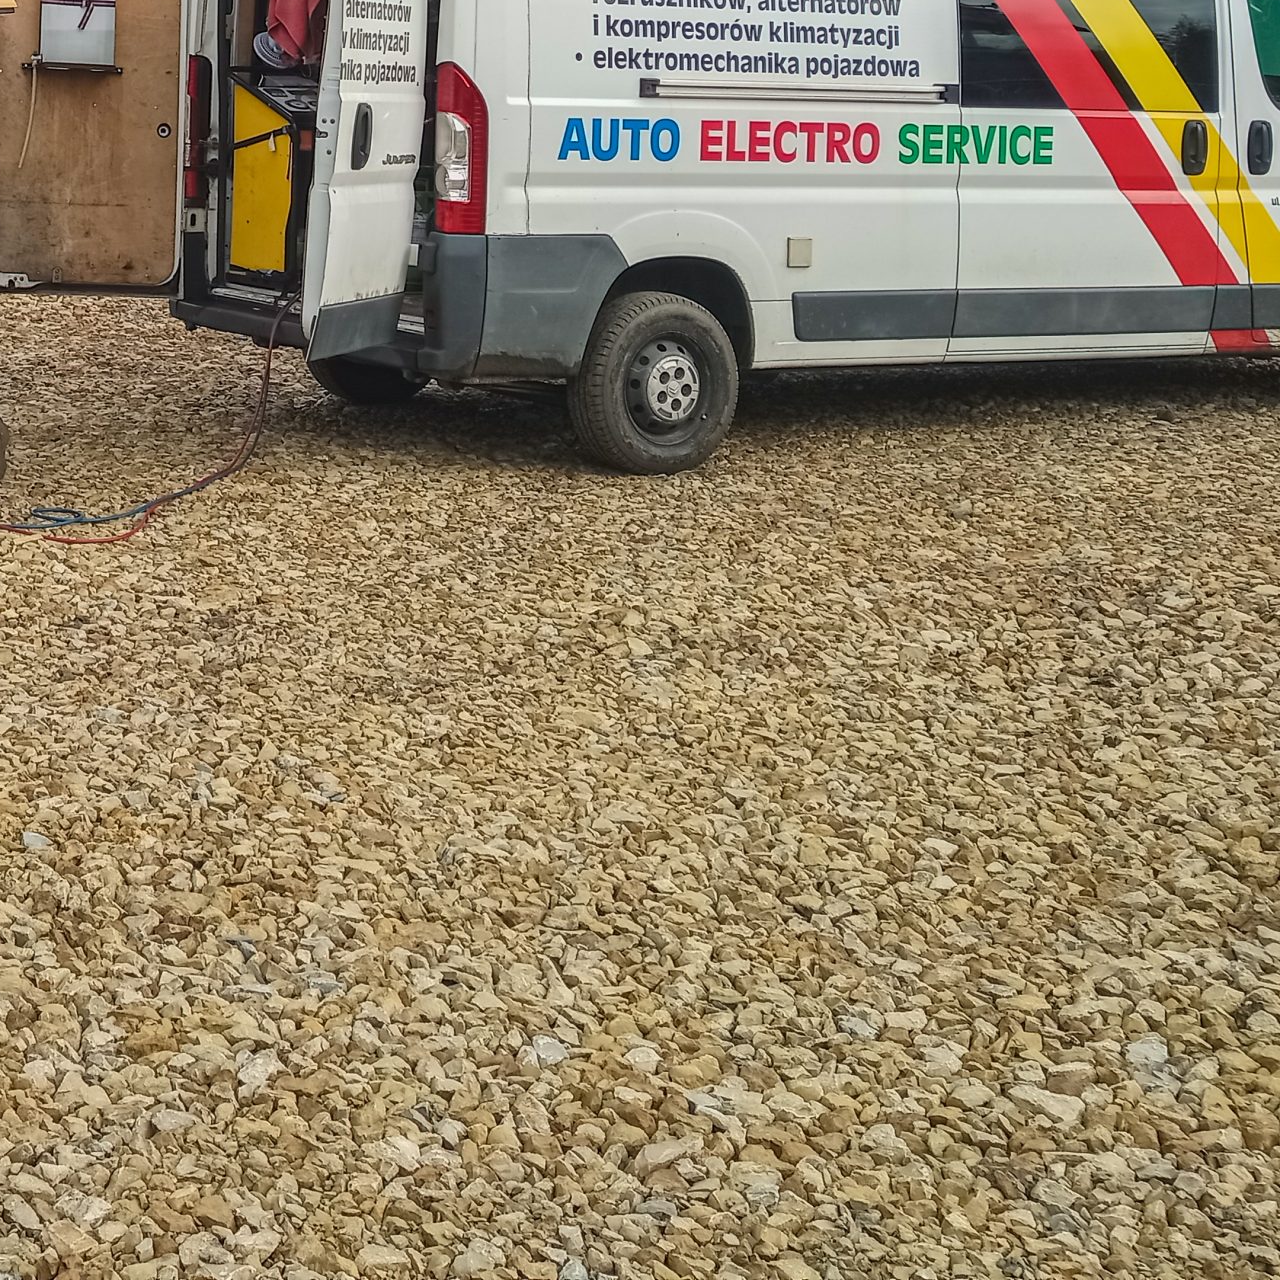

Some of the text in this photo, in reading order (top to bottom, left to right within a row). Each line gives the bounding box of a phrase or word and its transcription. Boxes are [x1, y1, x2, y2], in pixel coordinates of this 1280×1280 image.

[349, 27, 410, 56] klimatyzacji
[593, 14, 900, 50] i kompresorów klimatyzacji
[364, 61, 417, 85] pojazdowa
[593, 47, 920, 79] elektromechanika pojazdowa
[558, 117, 1054, 166] AUTO ELECTRO SERVICE
